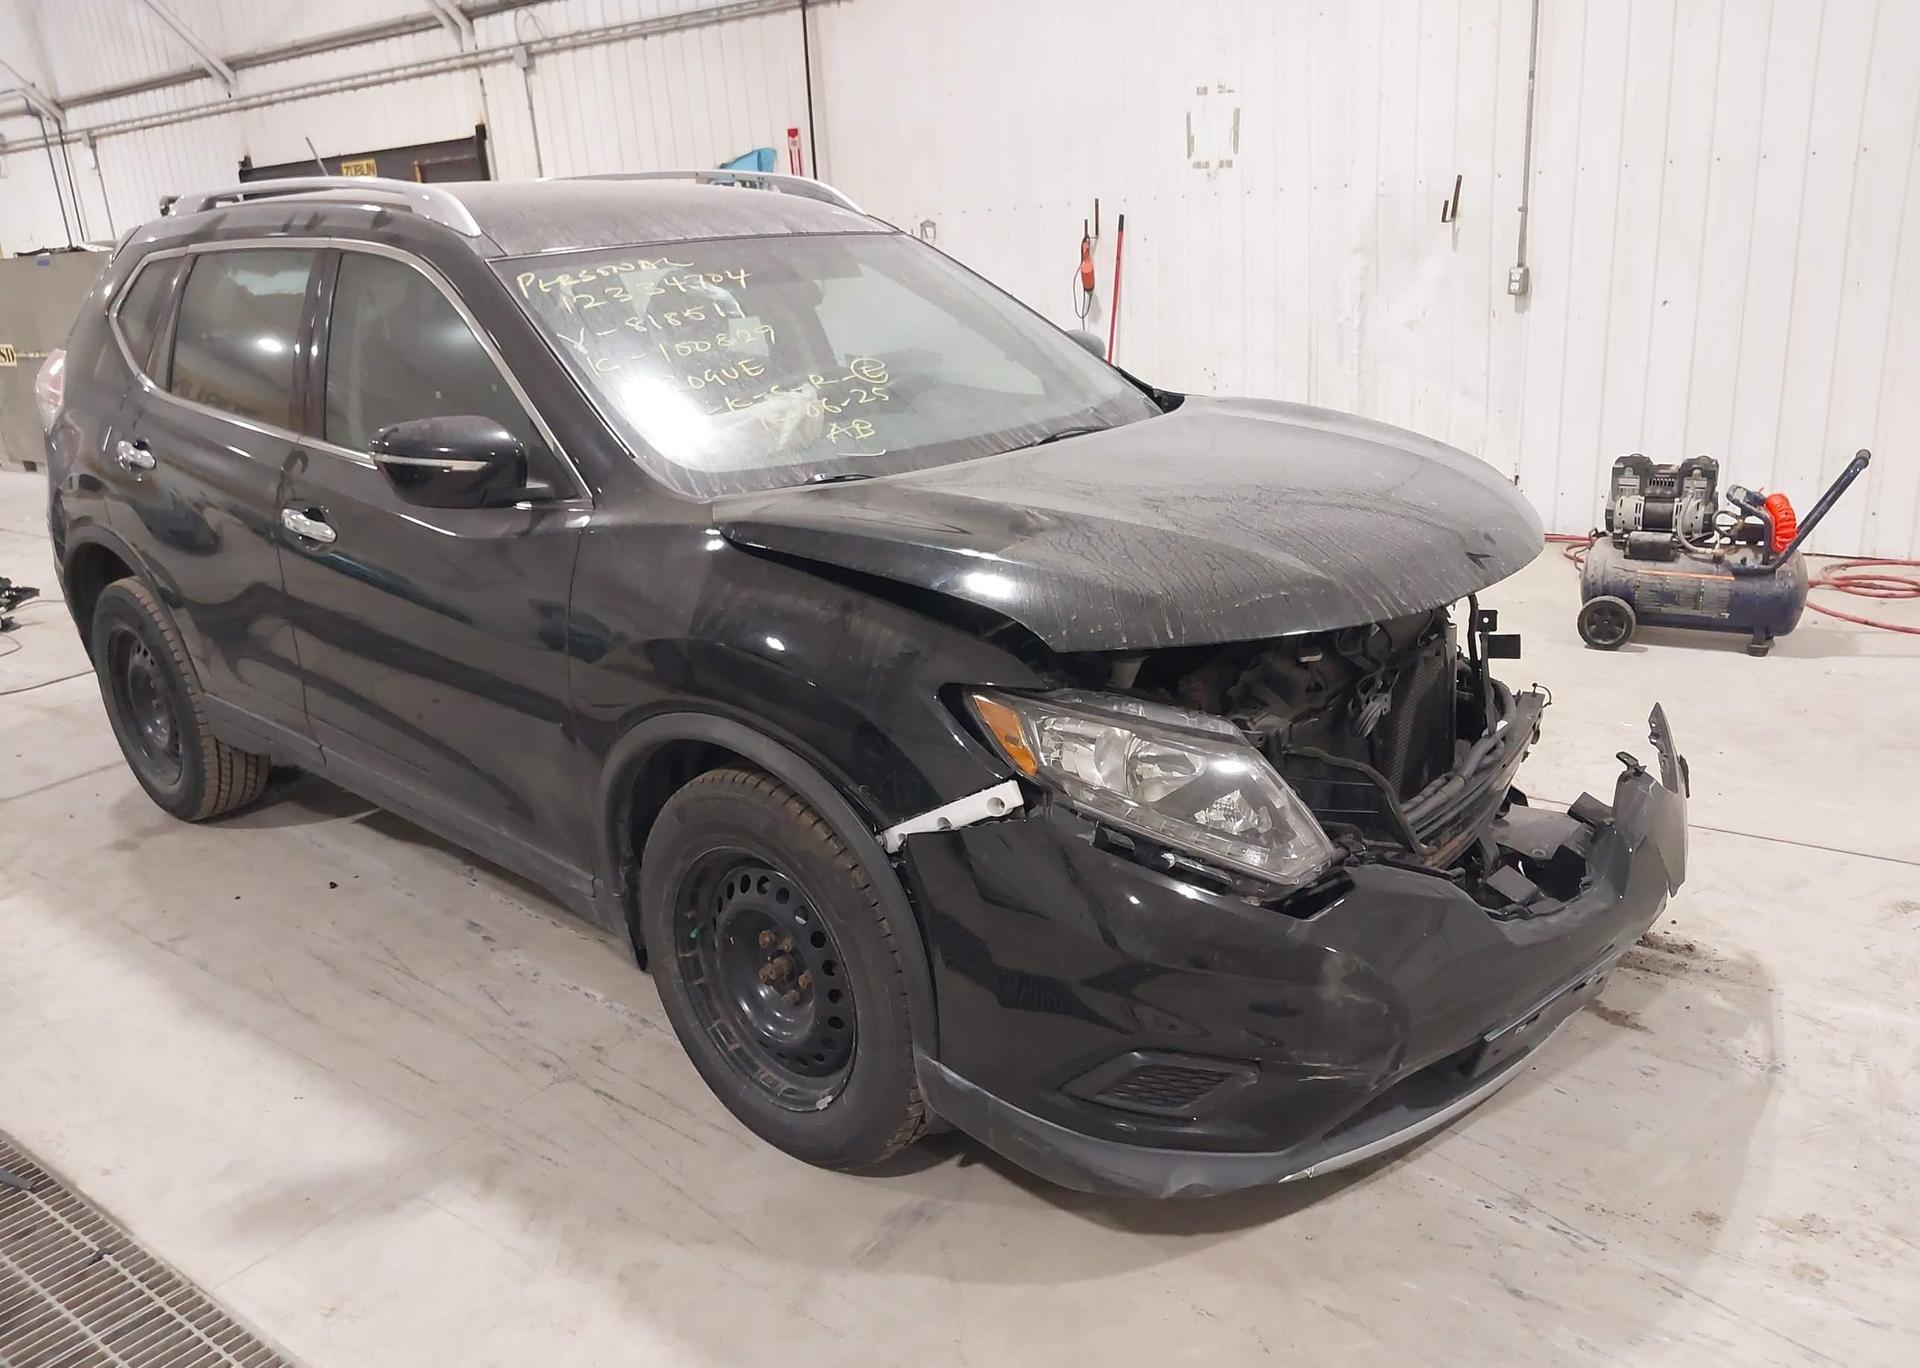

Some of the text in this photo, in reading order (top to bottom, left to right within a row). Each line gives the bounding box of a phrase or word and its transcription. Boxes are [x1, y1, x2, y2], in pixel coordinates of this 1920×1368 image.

[516, 257, 695, 299] PERSONAL
[670, 358, 766, 390] OGUE
[826, 419, 876, 444] AB
